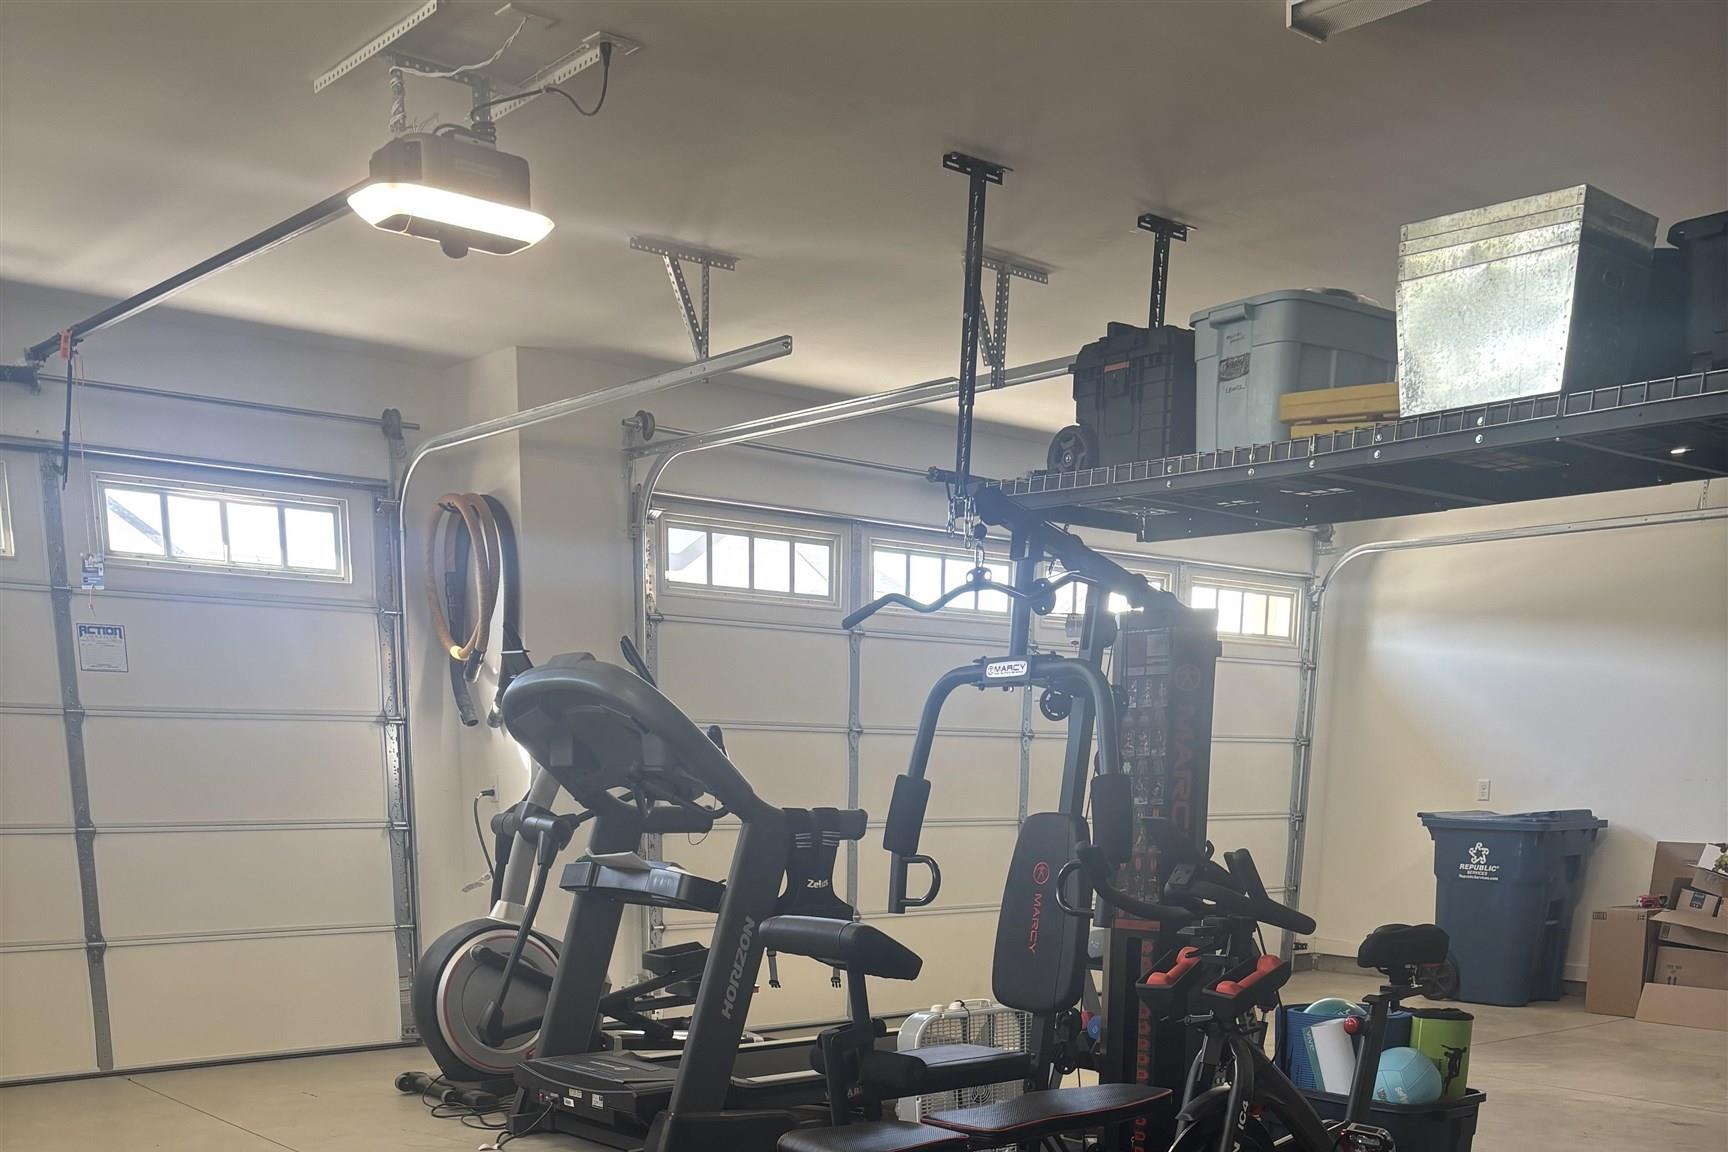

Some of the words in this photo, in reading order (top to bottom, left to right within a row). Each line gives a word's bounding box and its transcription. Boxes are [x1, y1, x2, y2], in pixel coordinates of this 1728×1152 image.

[78, 625, 123, 640] ACTION
[995, 663, 1026, 673] MARCY
[1028, 892, 1042, 953] MARCY
[721, 914, 756, 1020] HORIZON
[1237, 1100, 1249, 1131] IC4
